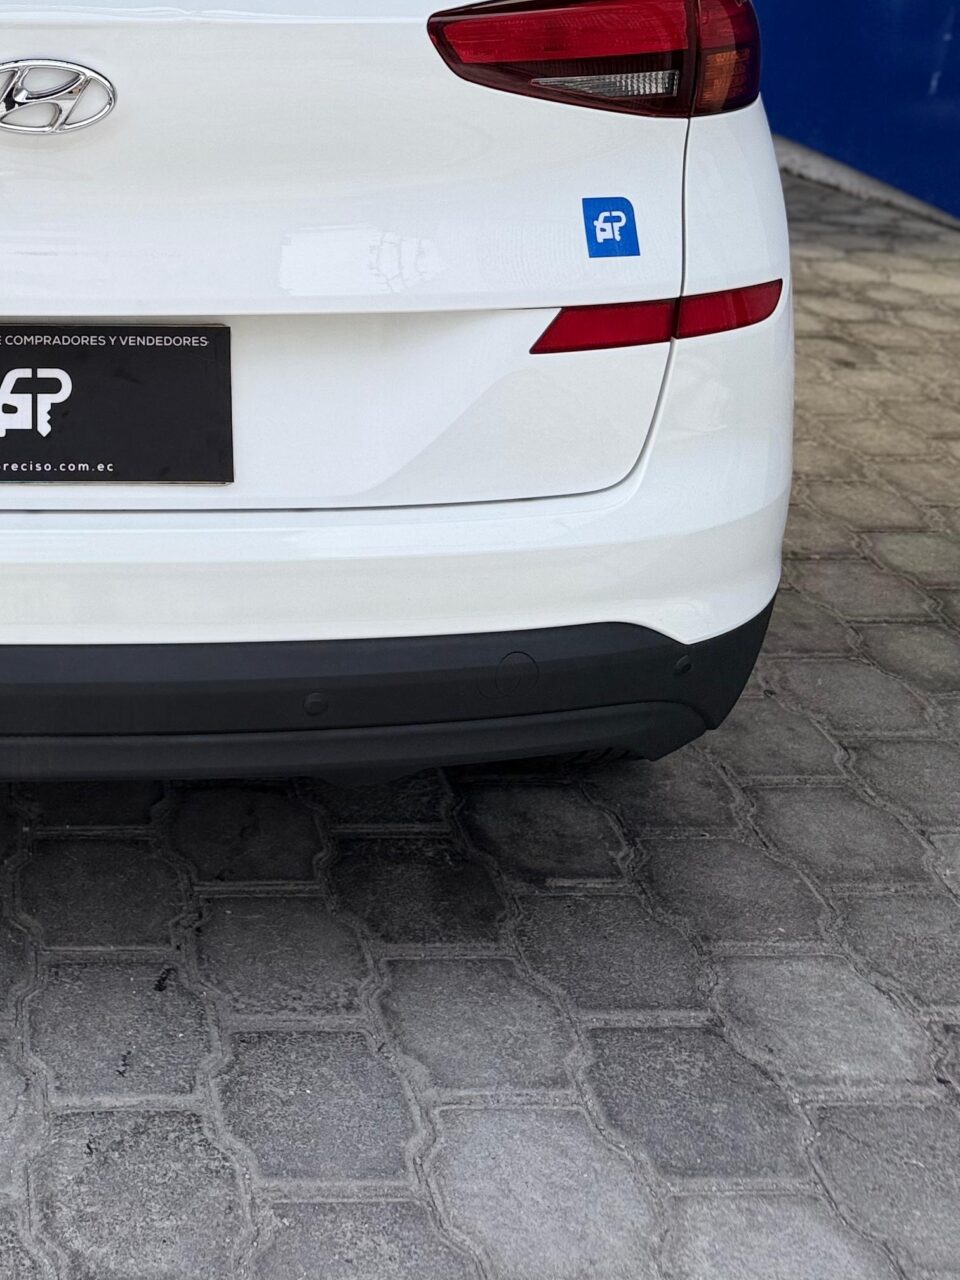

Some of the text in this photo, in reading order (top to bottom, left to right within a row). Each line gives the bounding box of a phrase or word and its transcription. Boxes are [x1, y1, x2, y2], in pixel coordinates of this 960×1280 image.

[5, 335, 106, 347] COMPRADORES
[109, 336, 118, 347] Y
[119, 336, 209, 347] VENDEDORES
